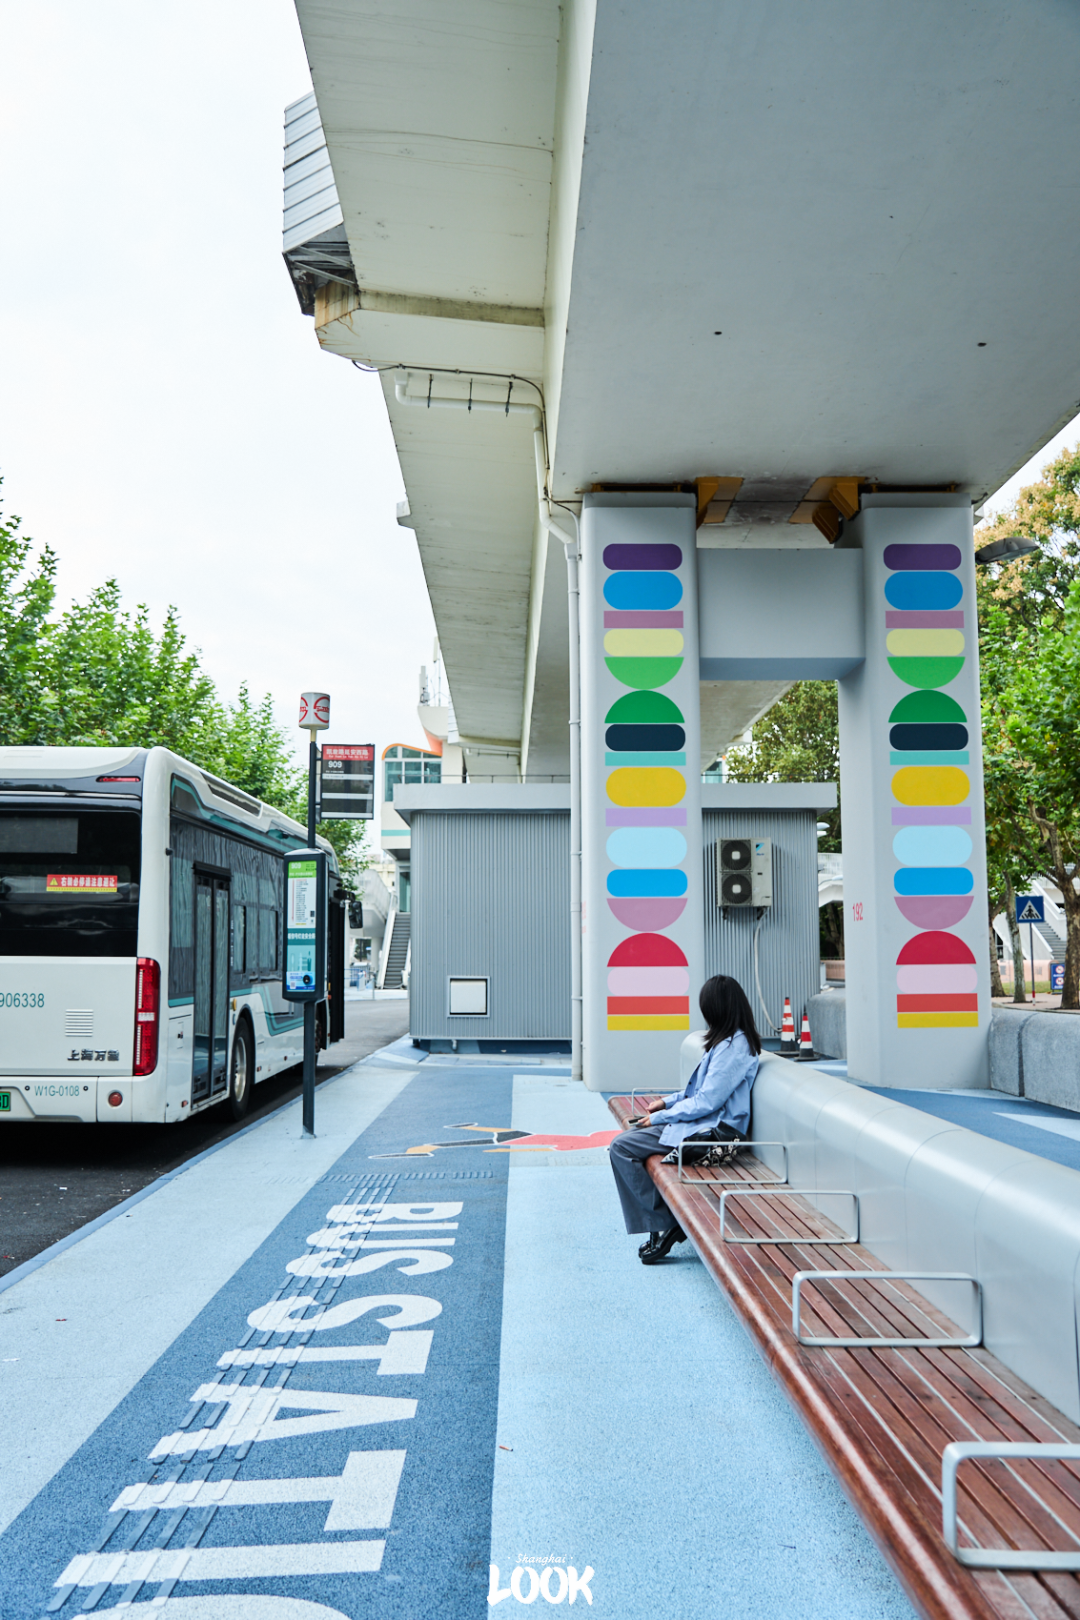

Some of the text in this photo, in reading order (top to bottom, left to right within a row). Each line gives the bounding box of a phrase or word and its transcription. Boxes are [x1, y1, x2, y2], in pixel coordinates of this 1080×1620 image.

[328, 760, 342, 768] 909
[61, 876, 115, 887] 右转必停请注意避让
[852, 902, 863, 922] 192
[0, 992, 45, 1008] 906338
[34, 1085, 80, 1097] W1G-0108
[50, 1201, 464, 1620] BUS STATI
